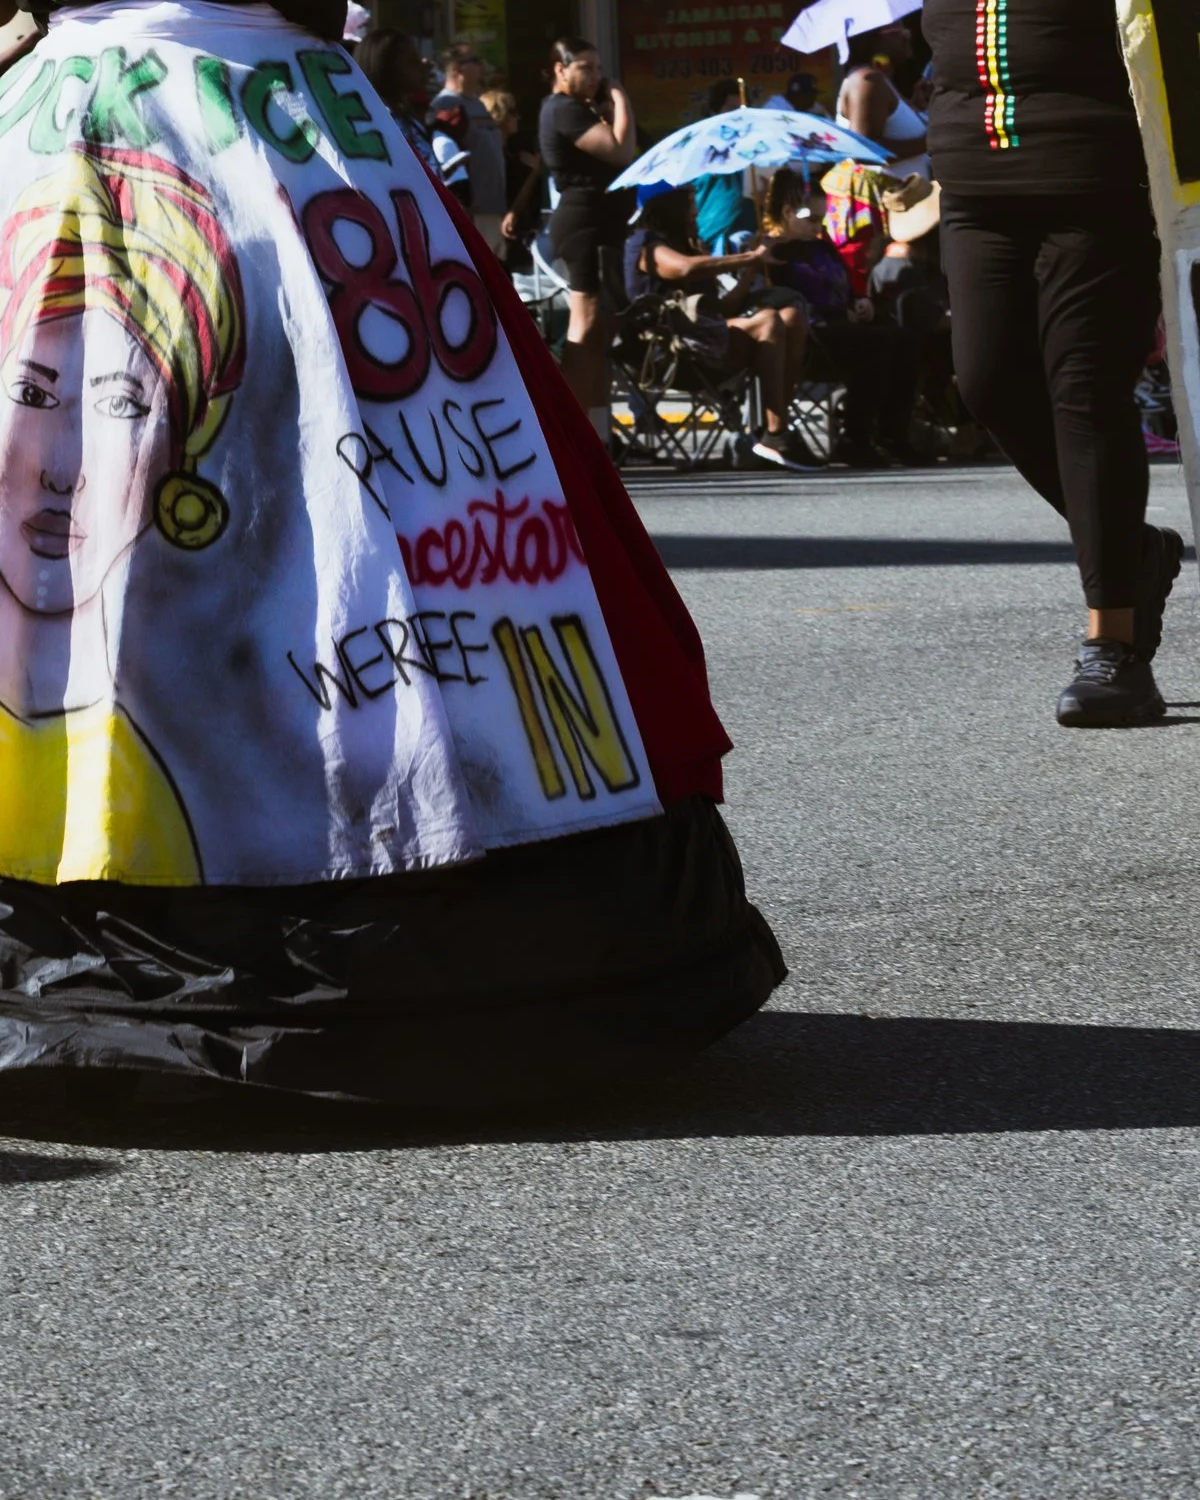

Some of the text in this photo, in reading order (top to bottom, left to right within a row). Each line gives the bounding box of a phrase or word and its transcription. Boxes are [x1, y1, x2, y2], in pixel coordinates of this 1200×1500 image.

[194, 48, 394, 166] ICE
[300, 186, 499, 402] 86
[491, 614, 642, 802] IN
